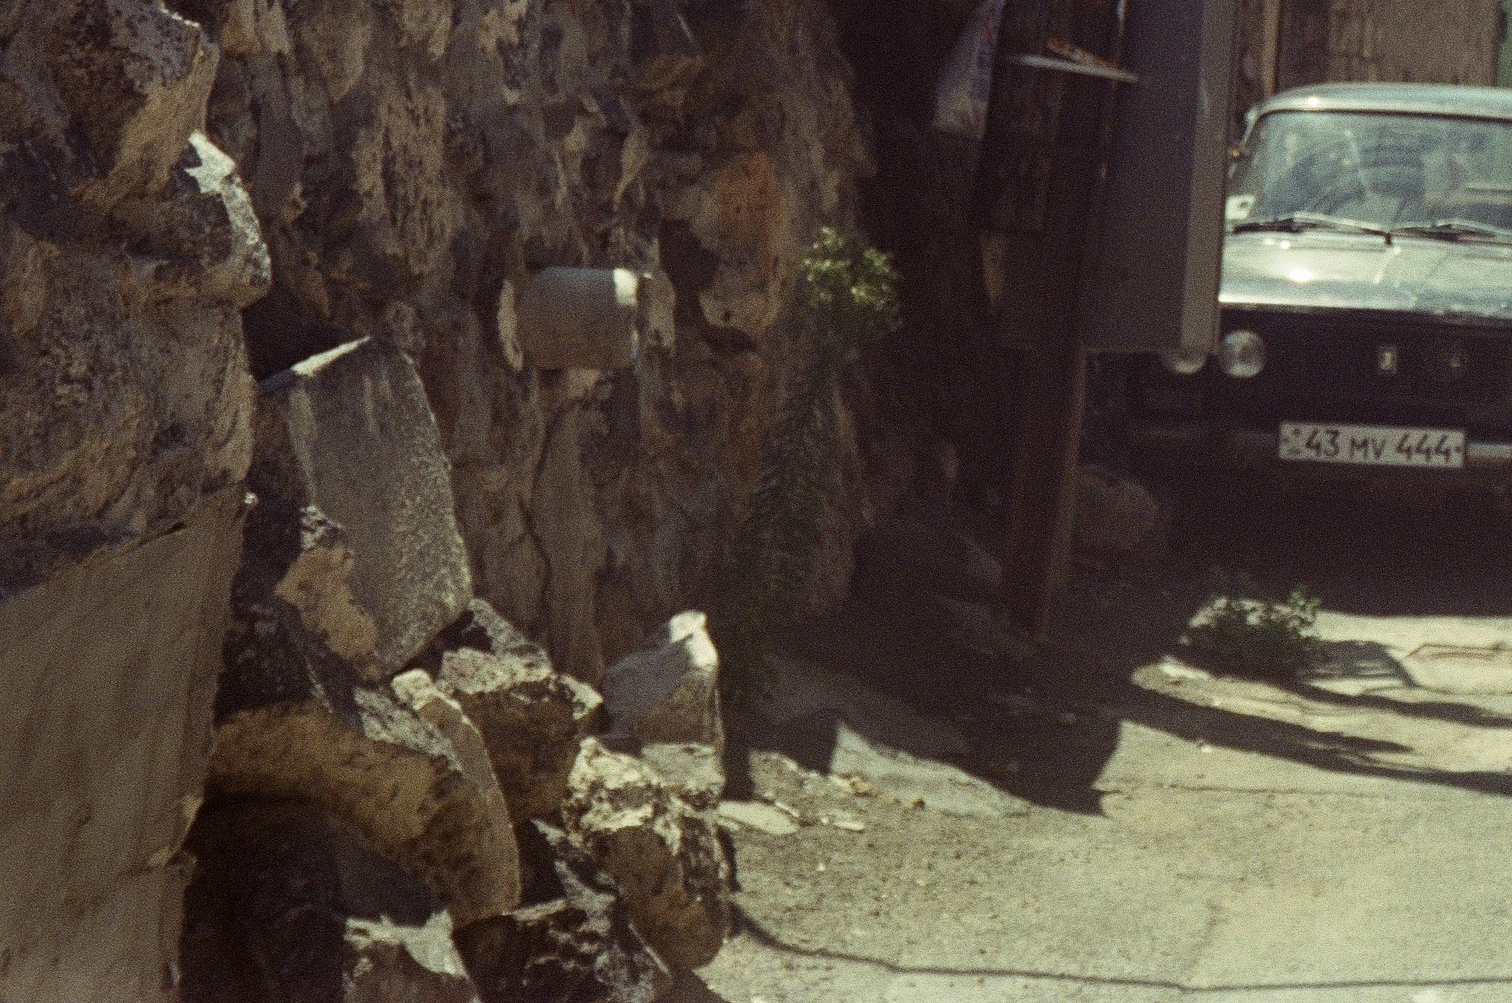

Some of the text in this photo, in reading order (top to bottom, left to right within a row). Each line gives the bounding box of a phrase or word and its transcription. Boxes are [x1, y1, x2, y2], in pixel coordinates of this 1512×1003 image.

[1305, 429, 1451, 463] 43 MV 444
